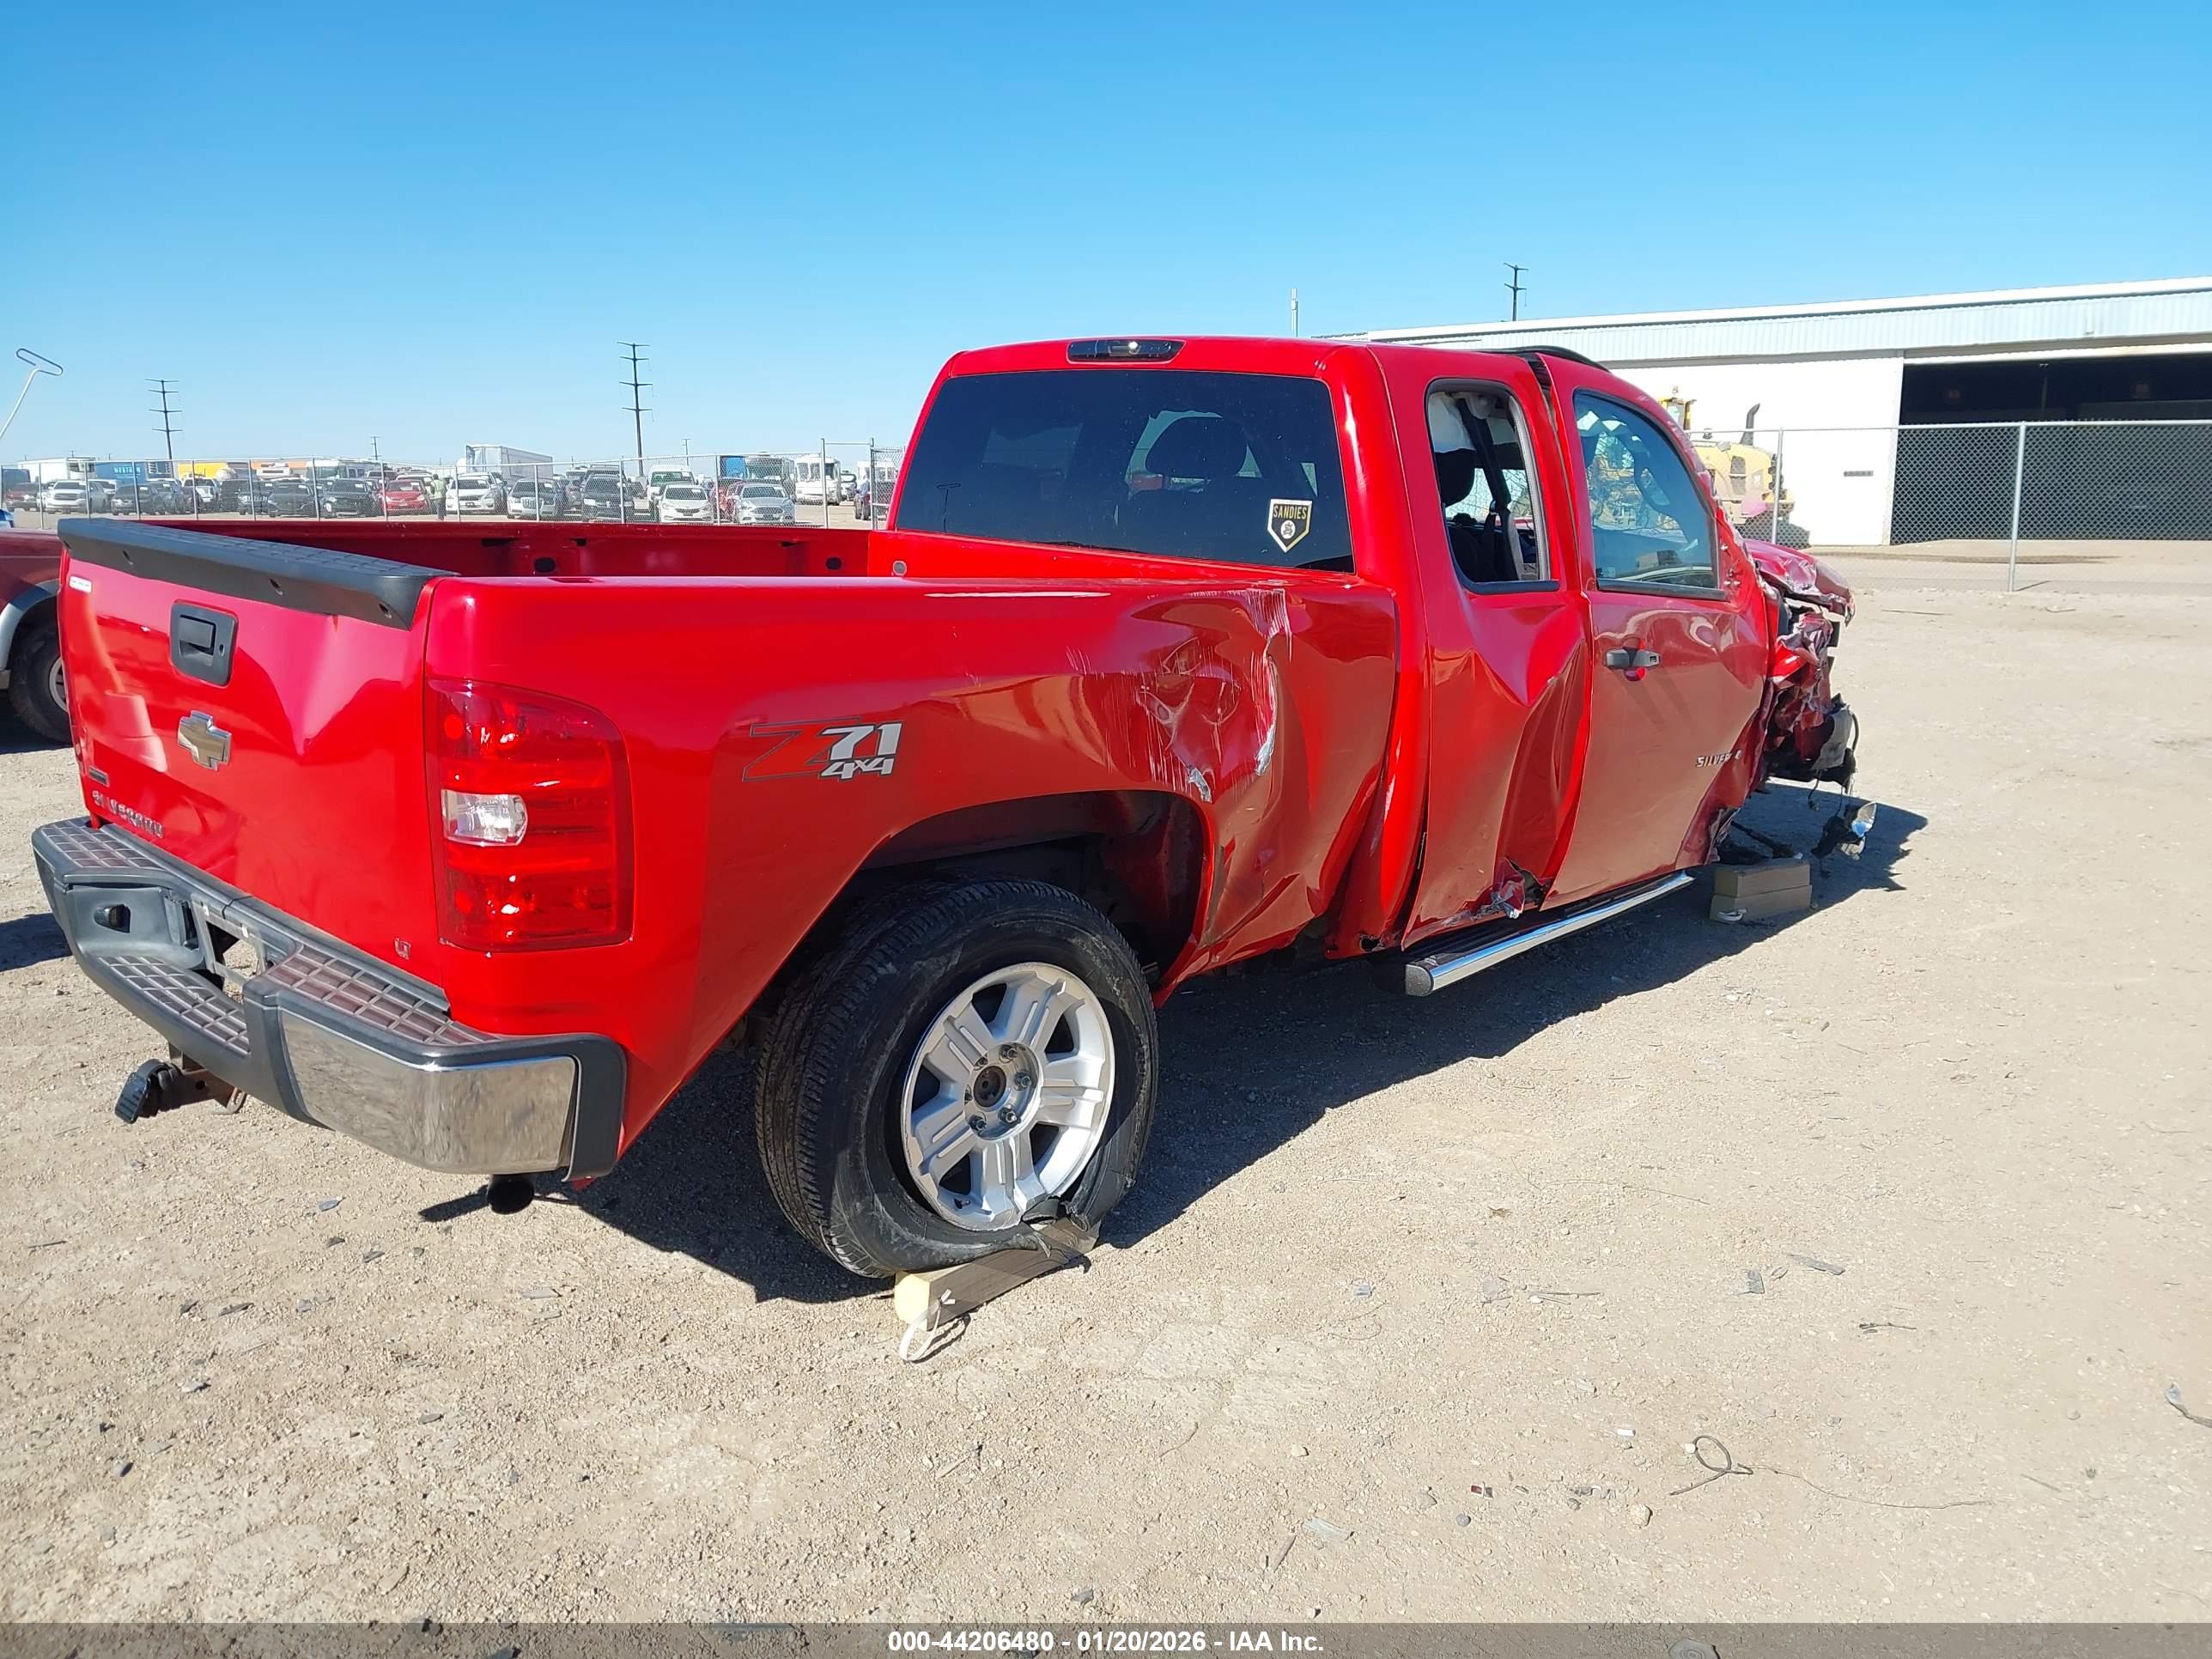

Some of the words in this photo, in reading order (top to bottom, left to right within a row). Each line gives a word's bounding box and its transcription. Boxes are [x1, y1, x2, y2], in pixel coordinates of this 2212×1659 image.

[1273, 505, 1308, 520] SANDIES
[742, 716, 903, 782] Z71
[394, 937, 411, 961] LT
